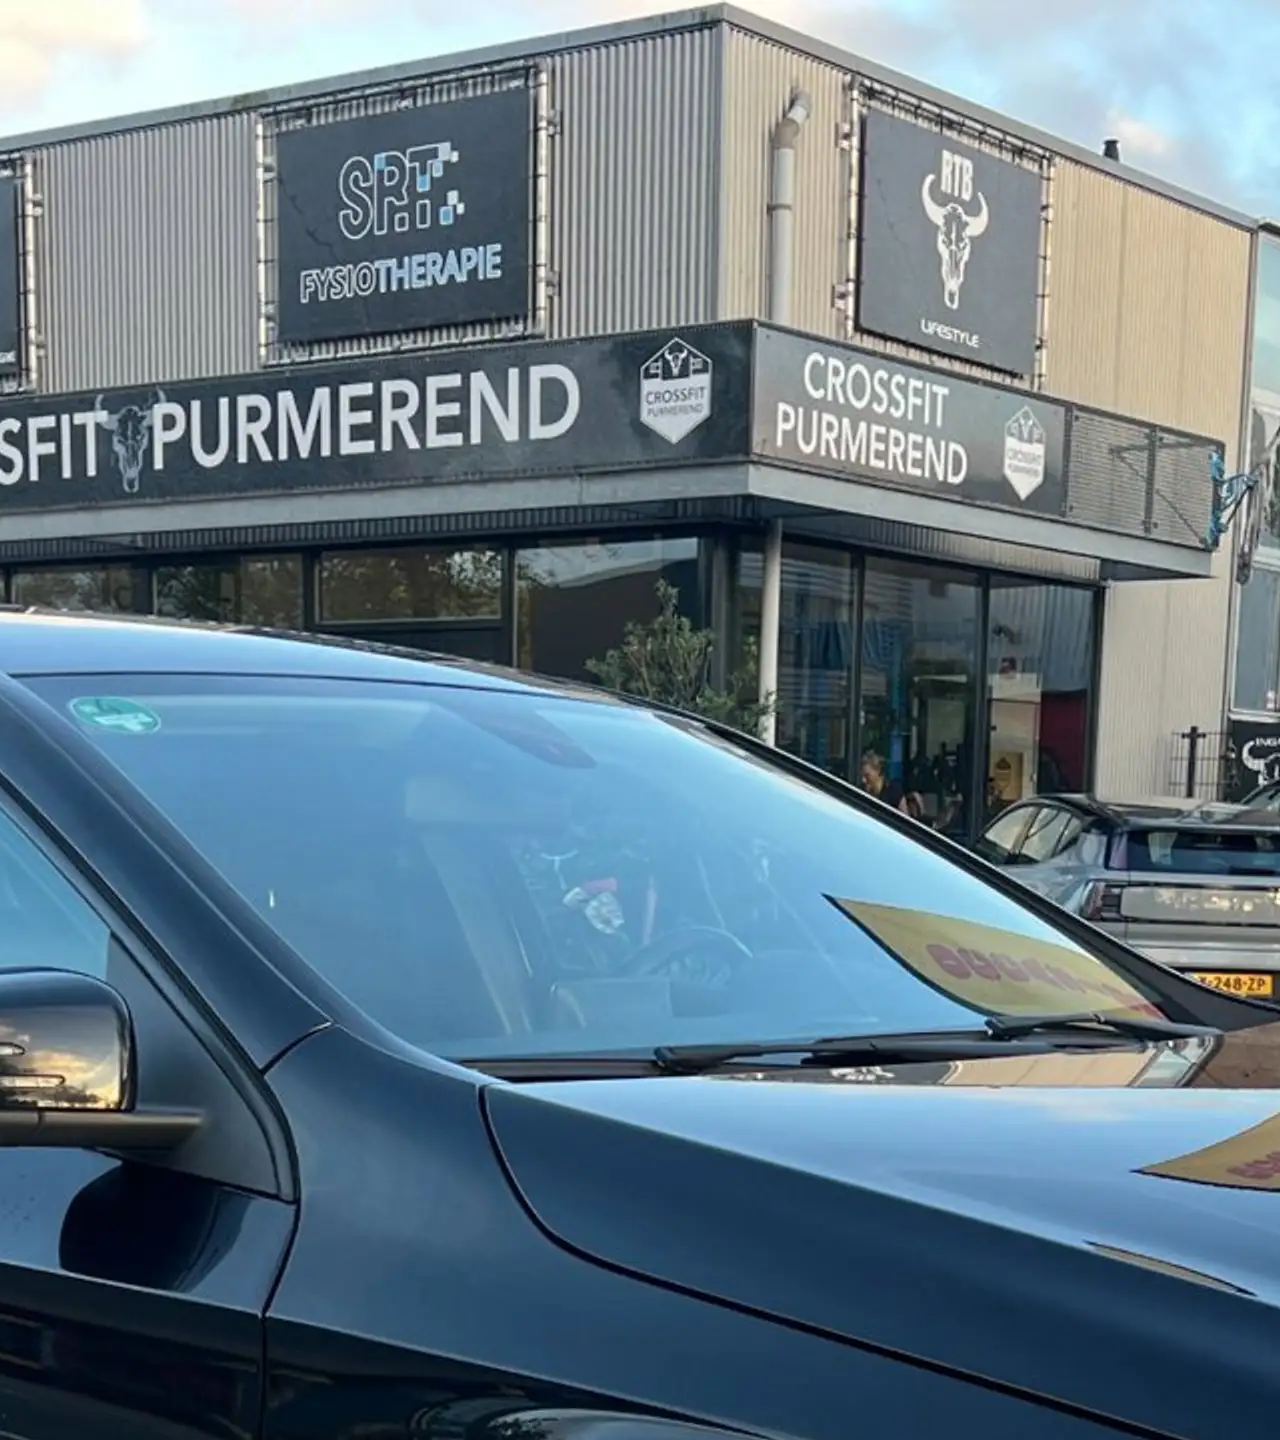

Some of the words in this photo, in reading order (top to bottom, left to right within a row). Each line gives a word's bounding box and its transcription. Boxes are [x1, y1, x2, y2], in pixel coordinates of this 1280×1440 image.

[339, 142, 451, 239] SRT
[941, 149, 973, 202] RTB
[300, 243, 502, 303] FYSIOTHERAPIE
[921, 318, 980, 348] LIFESTYLE
[153, 363, 580, 471] PURMEREND
[646, 386, 705, 405] CROSSFIT
[804, 352, 949, 427] CROSSFIT
[776, 402, 968, 484] PURMEREND
